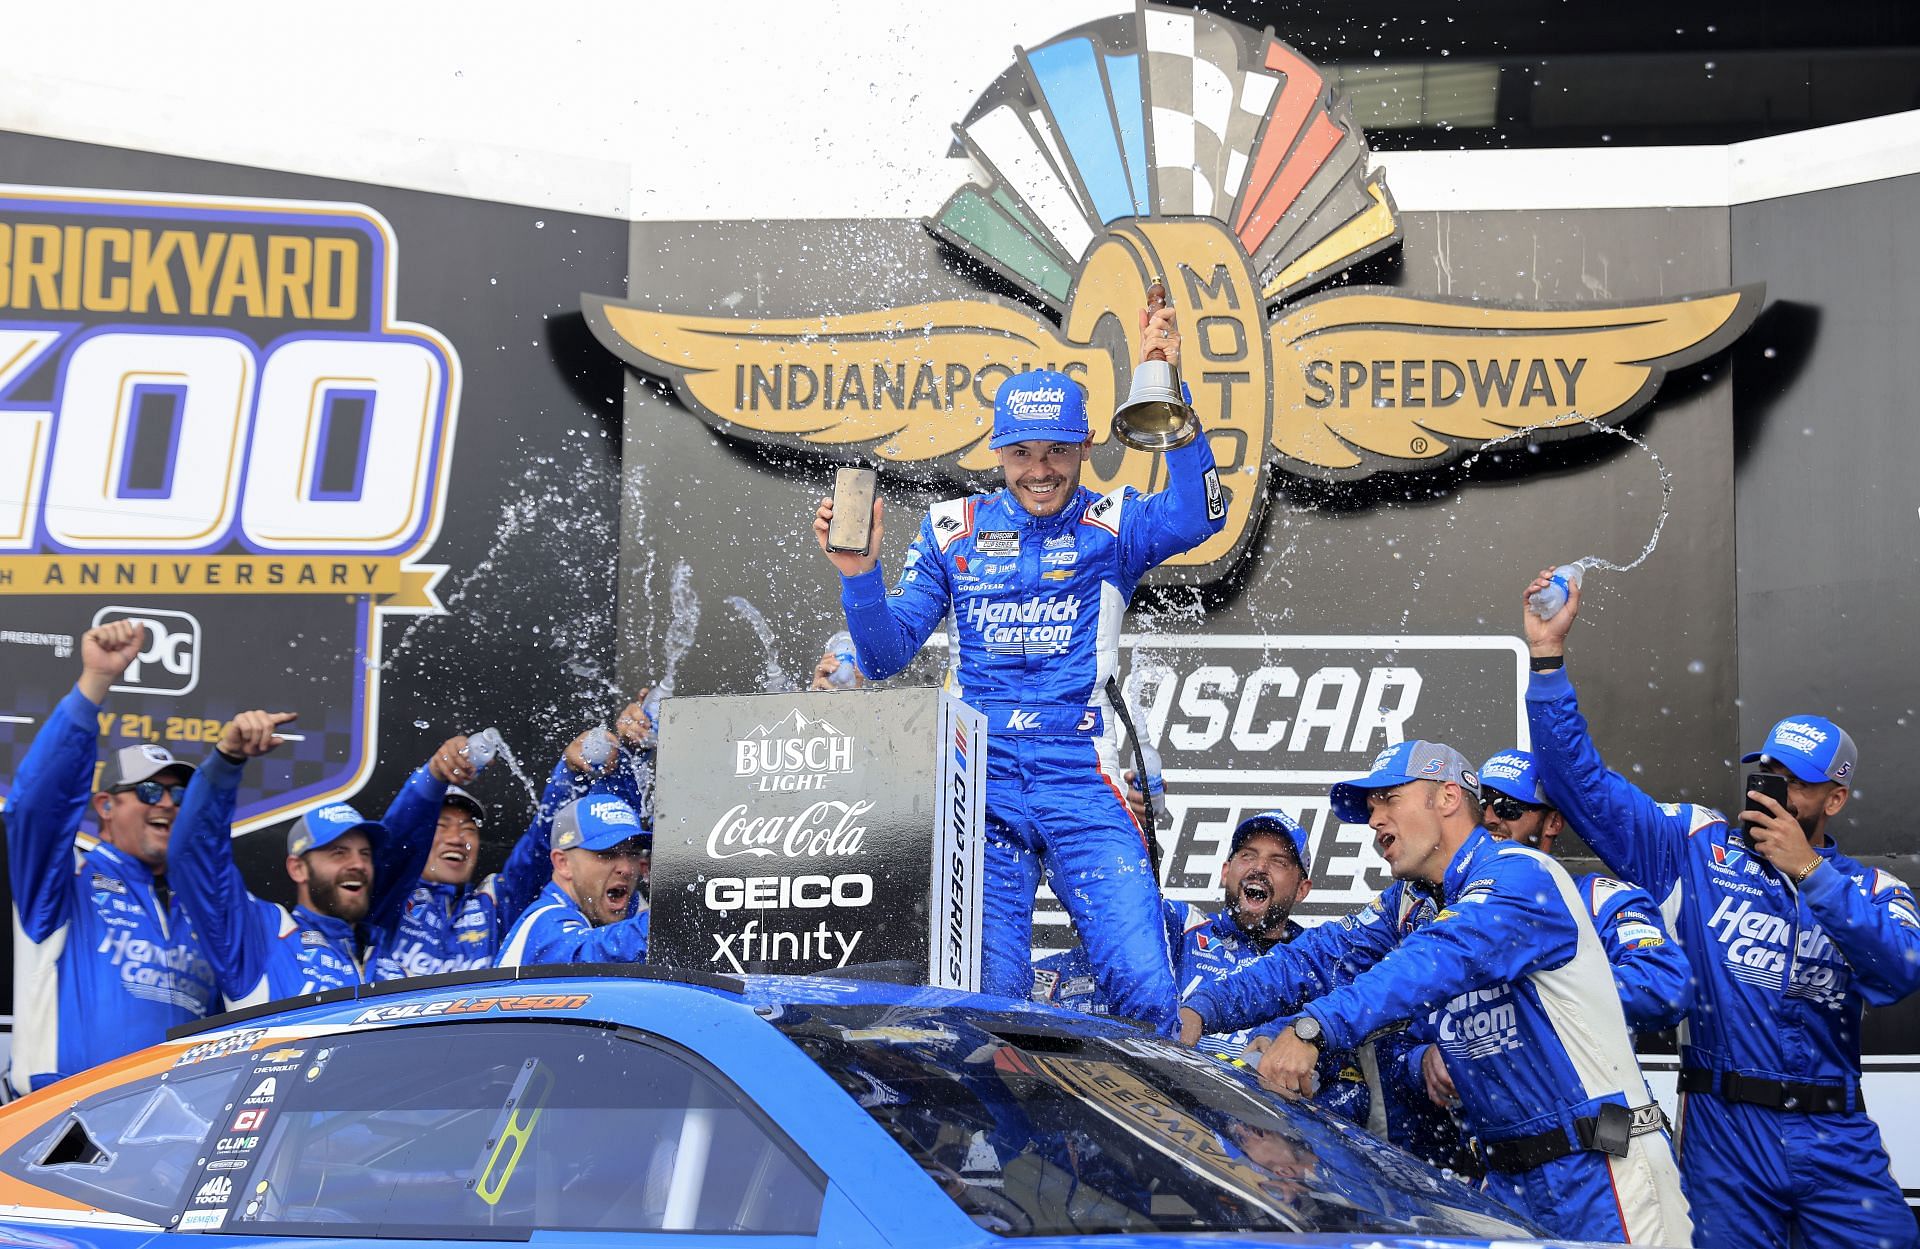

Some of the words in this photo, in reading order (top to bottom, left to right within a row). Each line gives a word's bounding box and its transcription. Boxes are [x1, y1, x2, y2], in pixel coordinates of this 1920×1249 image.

[0, 223, 359, 320] RICKYARD
[1177, 263, 1250, 506] MOTO
[1304, 357, 1588, 408] SPEEDWAY
[1006, 386, 1066, 410] Hendrick
[1013, 403, 1062, 415] Cars.com
[44, 562, 379, 585] ANNIVERSARY
[957, 582, 1005, 592] GOODYEAR
[966, 594, 1082, 632] Hendrick
[0, 630, 74, 647] PRESENTED
[983, 623, 1074, 643] Cars.com
[54, 645, 74, 659] BY
[1116, 666, 1423, 754] ASCAR
[120, 712, 160, 742] 21,
[1077, 711, 1097, 732] 5
[734, 735, 855, 778] BUSCH
[1421, 758, 1445, 775] 5
[1836, 761, 1851, 778] 5
[757, 773, 828, 792] LIGHT
[951, 771, 967, 848] CUP
[1707, 860, 1740, 877] Valvoline
[704, 873, 874, 911] GEICO
[1712, 877, 1764, 897] GOODYEAR
[948, 850, 966, 988] SERIES
[709, 919, 864, 976] xfinity
[1196, 962, 1229, 975] GOODY
[253, 1063, 301, 1074] CHEVROLET
[243, 1095, 275, 1105] AXALTA
[233, 1110, 267, 1130] CI
[216, 1136, 260, 1151] CLIMB
[196, 1175, 233, 1197] MAC
[195, 1194, 229, 1205] TOOLS
[184, 1215, 220, 1224] SIEMENS
